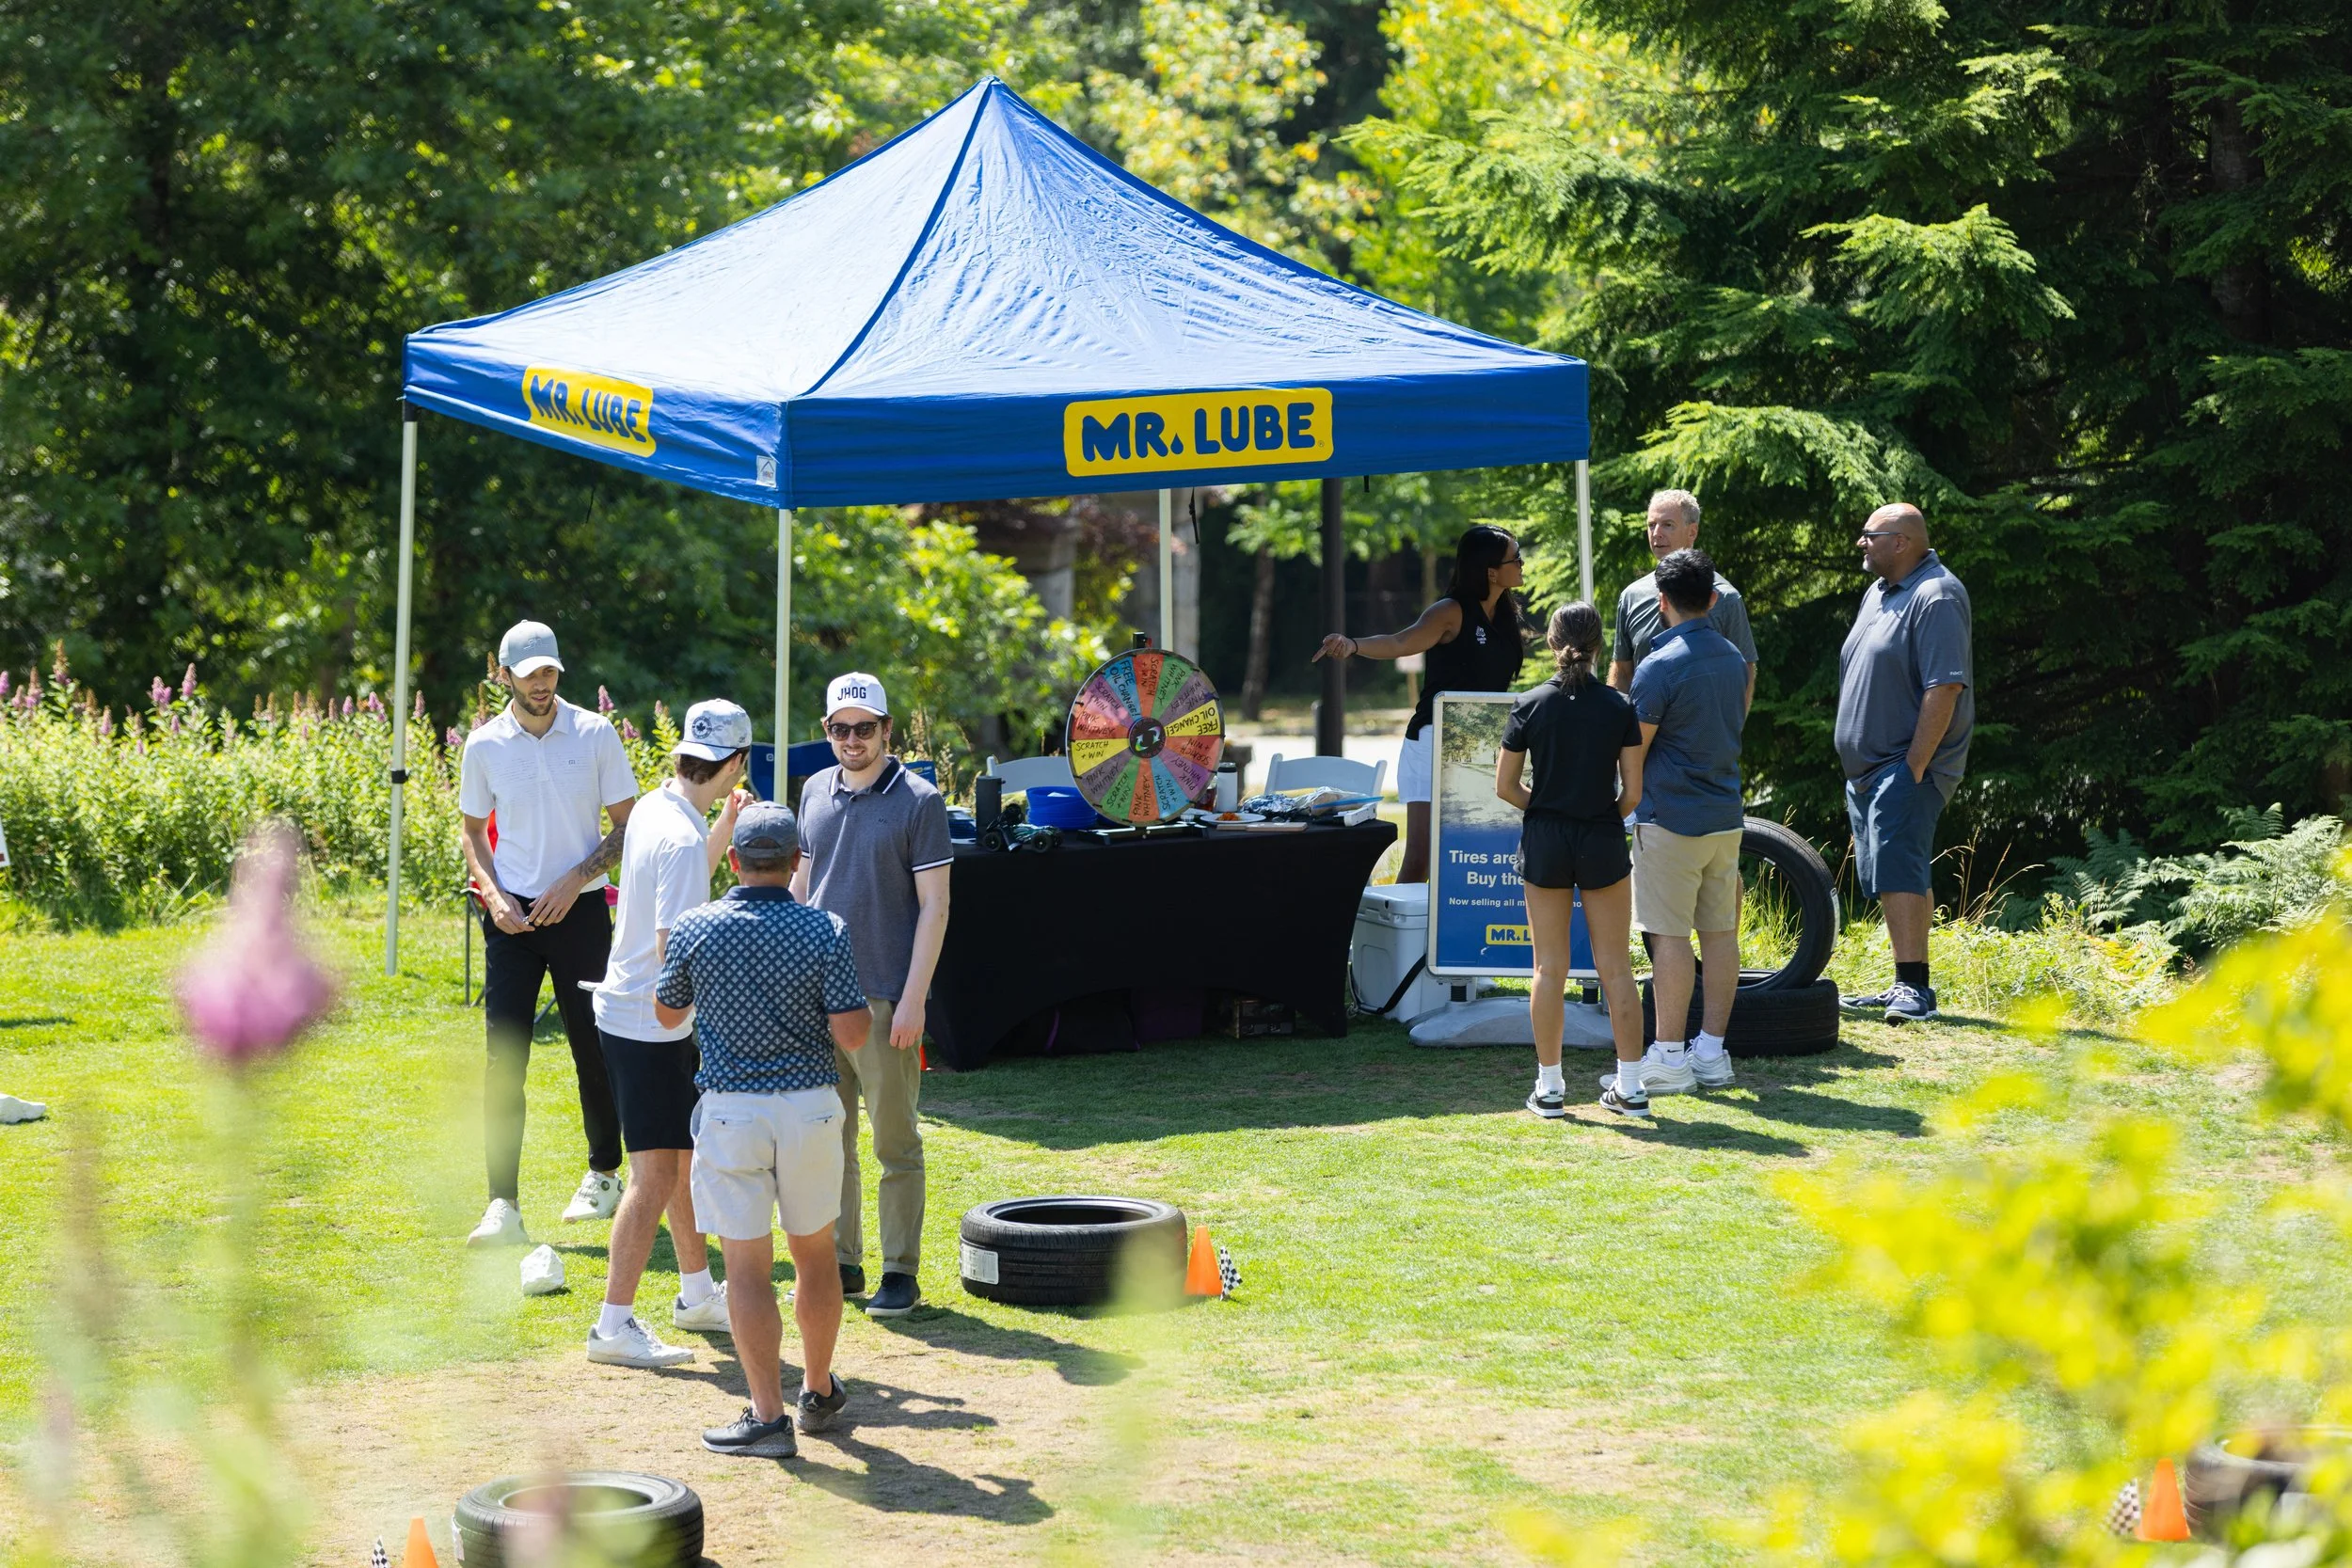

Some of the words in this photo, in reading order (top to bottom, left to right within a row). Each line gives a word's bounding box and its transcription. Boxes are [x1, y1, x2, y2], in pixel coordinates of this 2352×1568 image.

[530, 374, 584, 425] MR.
[581, 388, 647, 443] LUBE
[1082, 411, 1184, 463] MR.
[1194, 402, 1316, 455] LUBE
[1120, 660, 1136, 686] FREE
[1147, 657, 1159, 696] SCRATCH
[1171, 667, 1186, 689] PINK
[837, 687, 866, 701] JHOG
[1110, 666, 1121, 684] OIL
[1118, 684, 1141, 717] CHANGE!
[1158, 663, 1178, 705] WHITNEY
[1095, 681, 1121, 710] SCRATCH
[1200, 706, 1216, 720] OIL
[1076, 723, 1116, 735] WHITNEY
[1166, 715, 1200, 736] CHANGE!
[1197, 719, 1218, 736] FREE
[1075, 740, 1109, 752] SCRATCH
[1089, 750, 1104, 759] WIN
[1086, 767, 1104, 784] PINK
[1091, 762, 1119, 794] WHITNEY
[1170, 757, 1201, 782] WHITNEY
[1106, 772, 1129, 809] SCRATCH
[1154, 774, 1171, 810] SCRATCH
[1166, 779, 1175, 796] WIN
[1179, 773, 1198, 791] PINK
[1133, 792, 1142, 816] PINK
[1449, 850, 1488, 864] Tires
[1467, 871, 1497, 888] Buy
[1449, 897, 1469, 906] Now
[1471, 898, 1501, 908] selling
[1503, 898, 1515, 907] all
[1491, 928, 1520, 942] MR.
